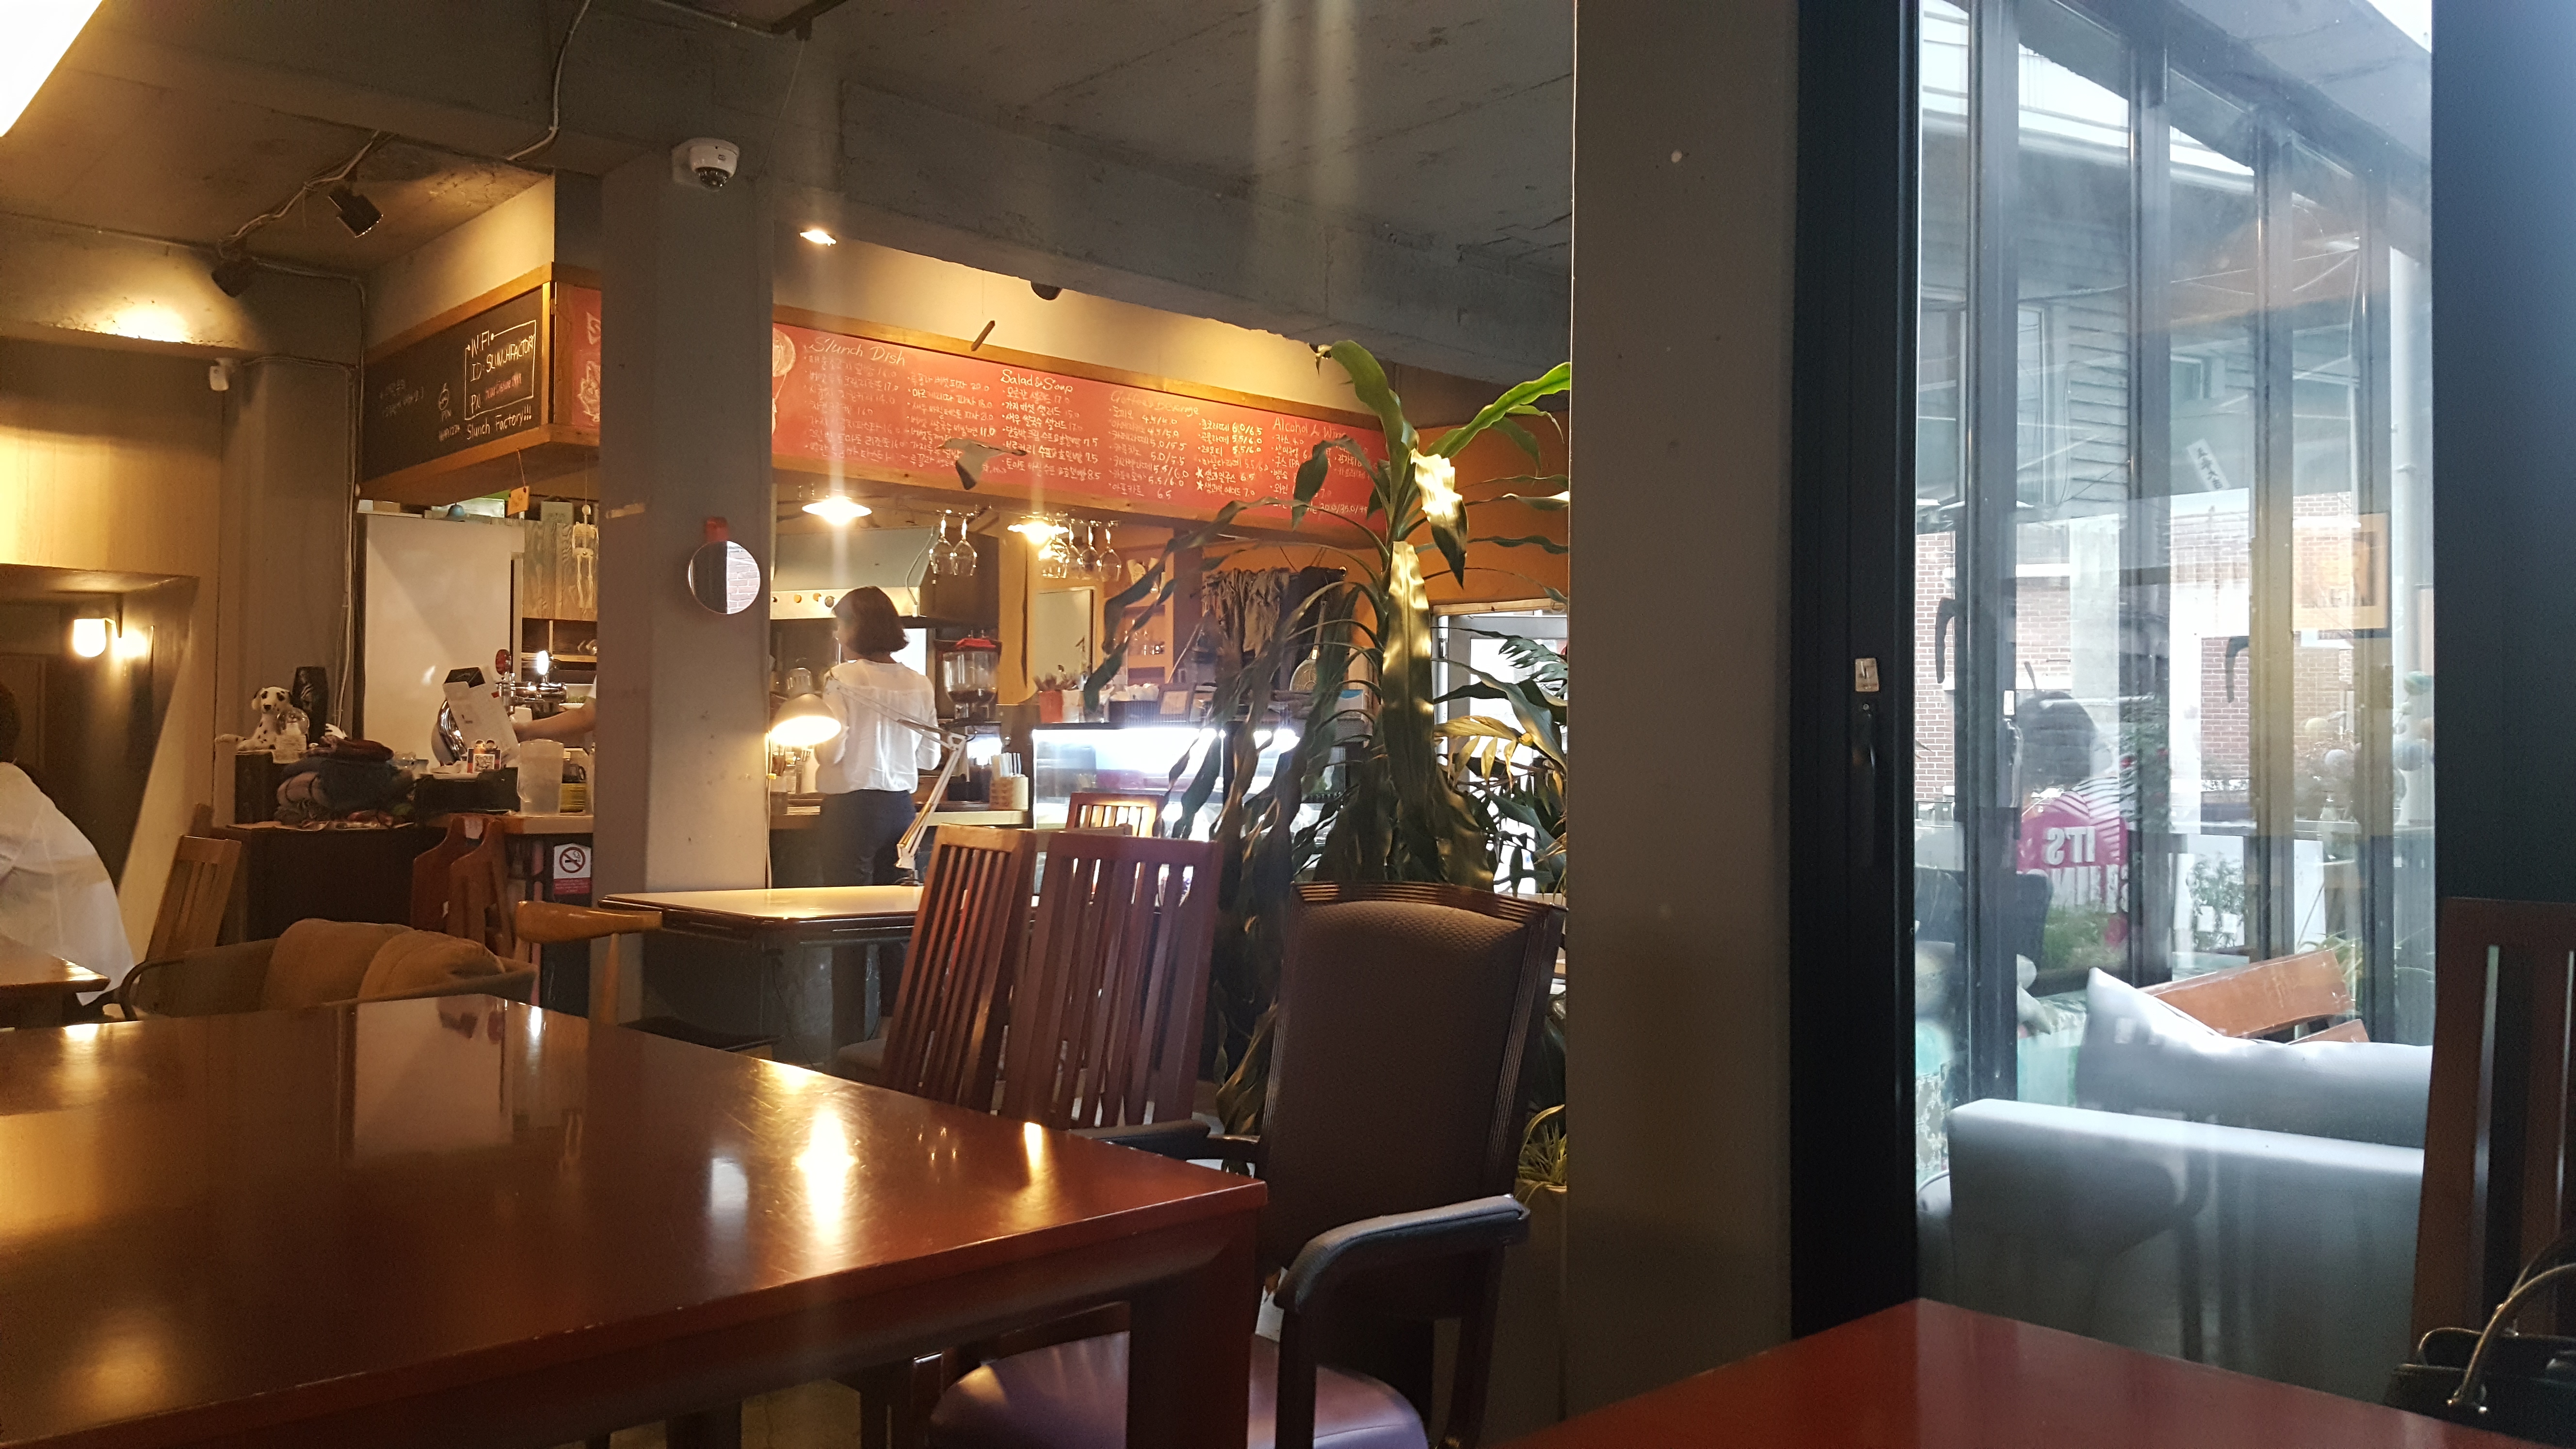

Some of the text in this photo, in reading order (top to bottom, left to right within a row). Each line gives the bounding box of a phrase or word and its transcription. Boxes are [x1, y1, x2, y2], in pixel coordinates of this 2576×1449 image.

[808, 337, 905, 366] Slunch Dish
[1000, 369, 1033, 386] Salad
[1043, 377, 1073, 394] Soup
[956, 395, 976, 405] 피자
[965, 411, 979, 419] 피자
[1005, 413, 1020, 425] 새우
[1023, 415, 1042, 428] 쌀국수
[467, 419, 490, 440] Slunch
[1272, 417, 1308, 434] Alcohol
[1006, 426, 1027, 440] 단호박
[1276, 434, 1290, 444] 카스
[1275, 456, 1287, 467] 구스
[1273, 483, 1288, 495] 와인
